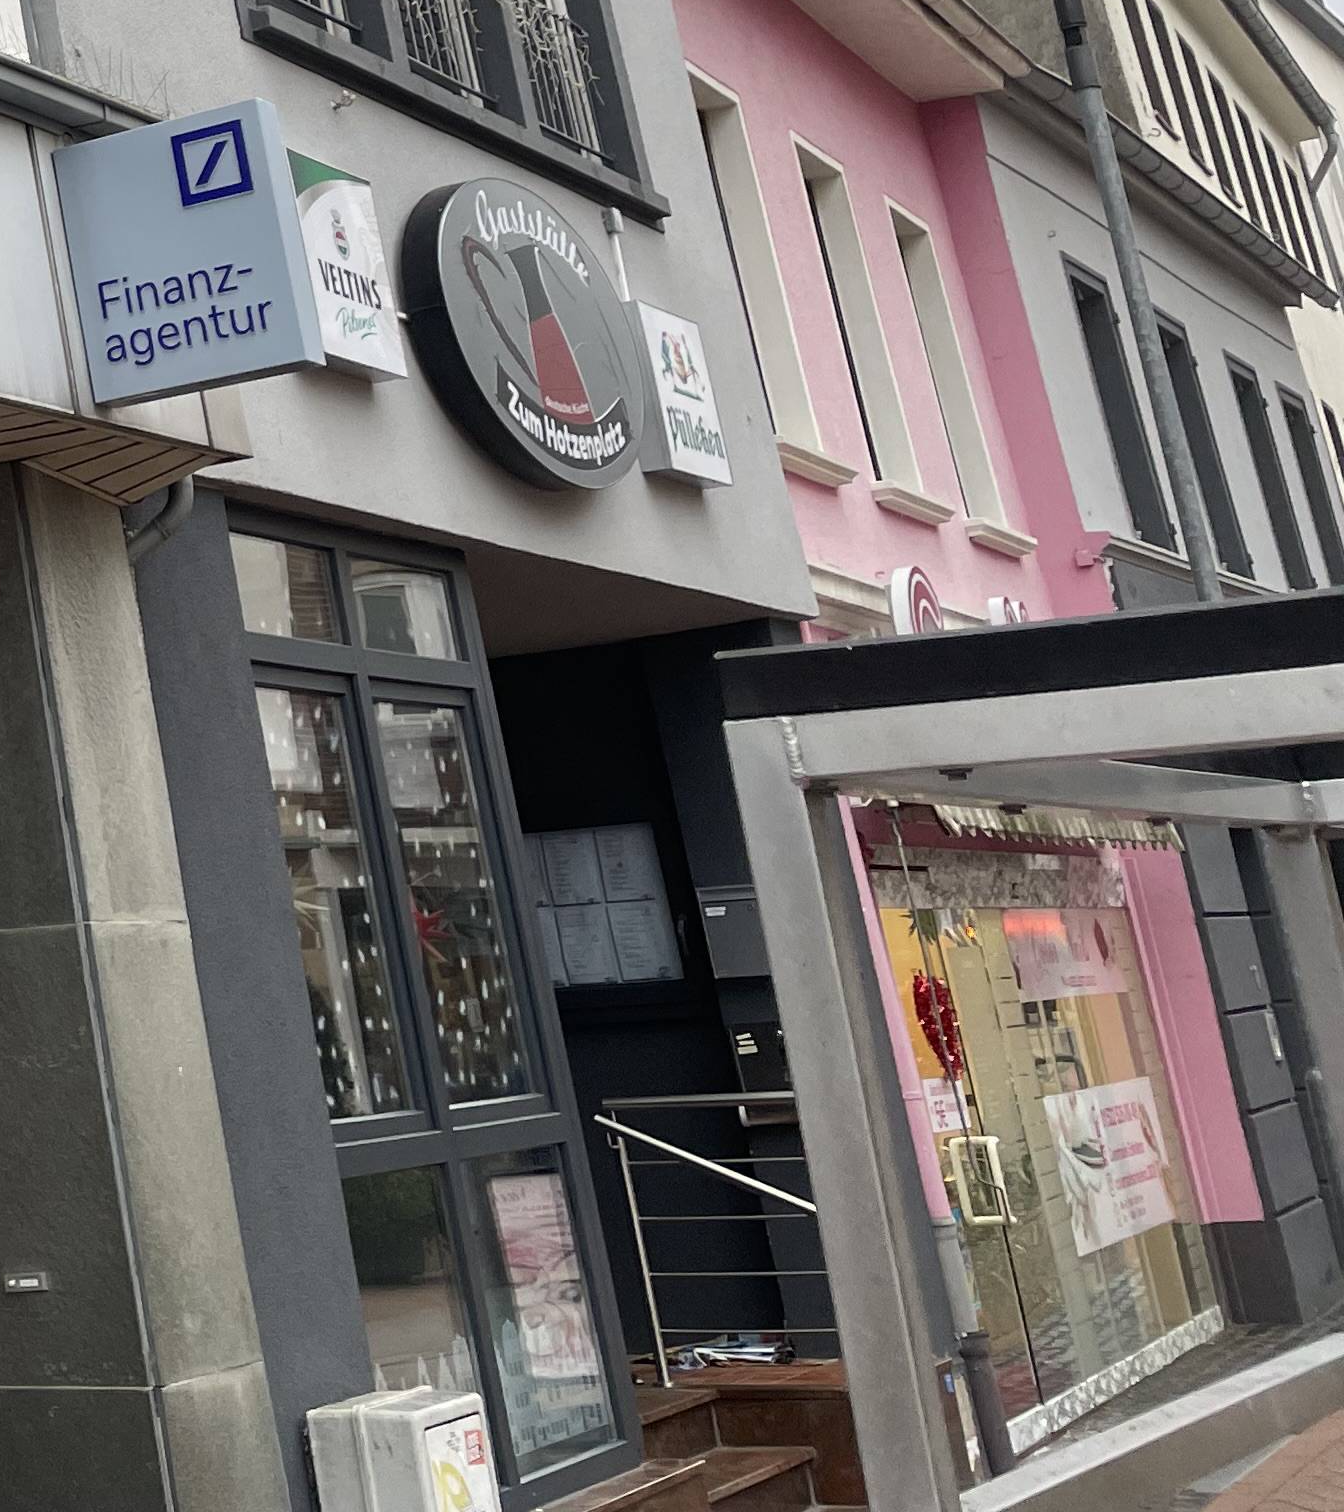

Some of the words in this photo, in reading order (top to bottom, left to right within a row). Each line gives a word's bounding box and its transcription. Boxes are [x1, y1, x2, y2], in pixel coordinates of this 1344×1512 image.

[98, 264, 253, 320] Finanz-
[318, 258, 382, 310] VELTINS
[106, 300, 273, 366] agentur
[507, 381, 544, 442] Zum
[543, 414, 626, 466] Hotzenplatz
